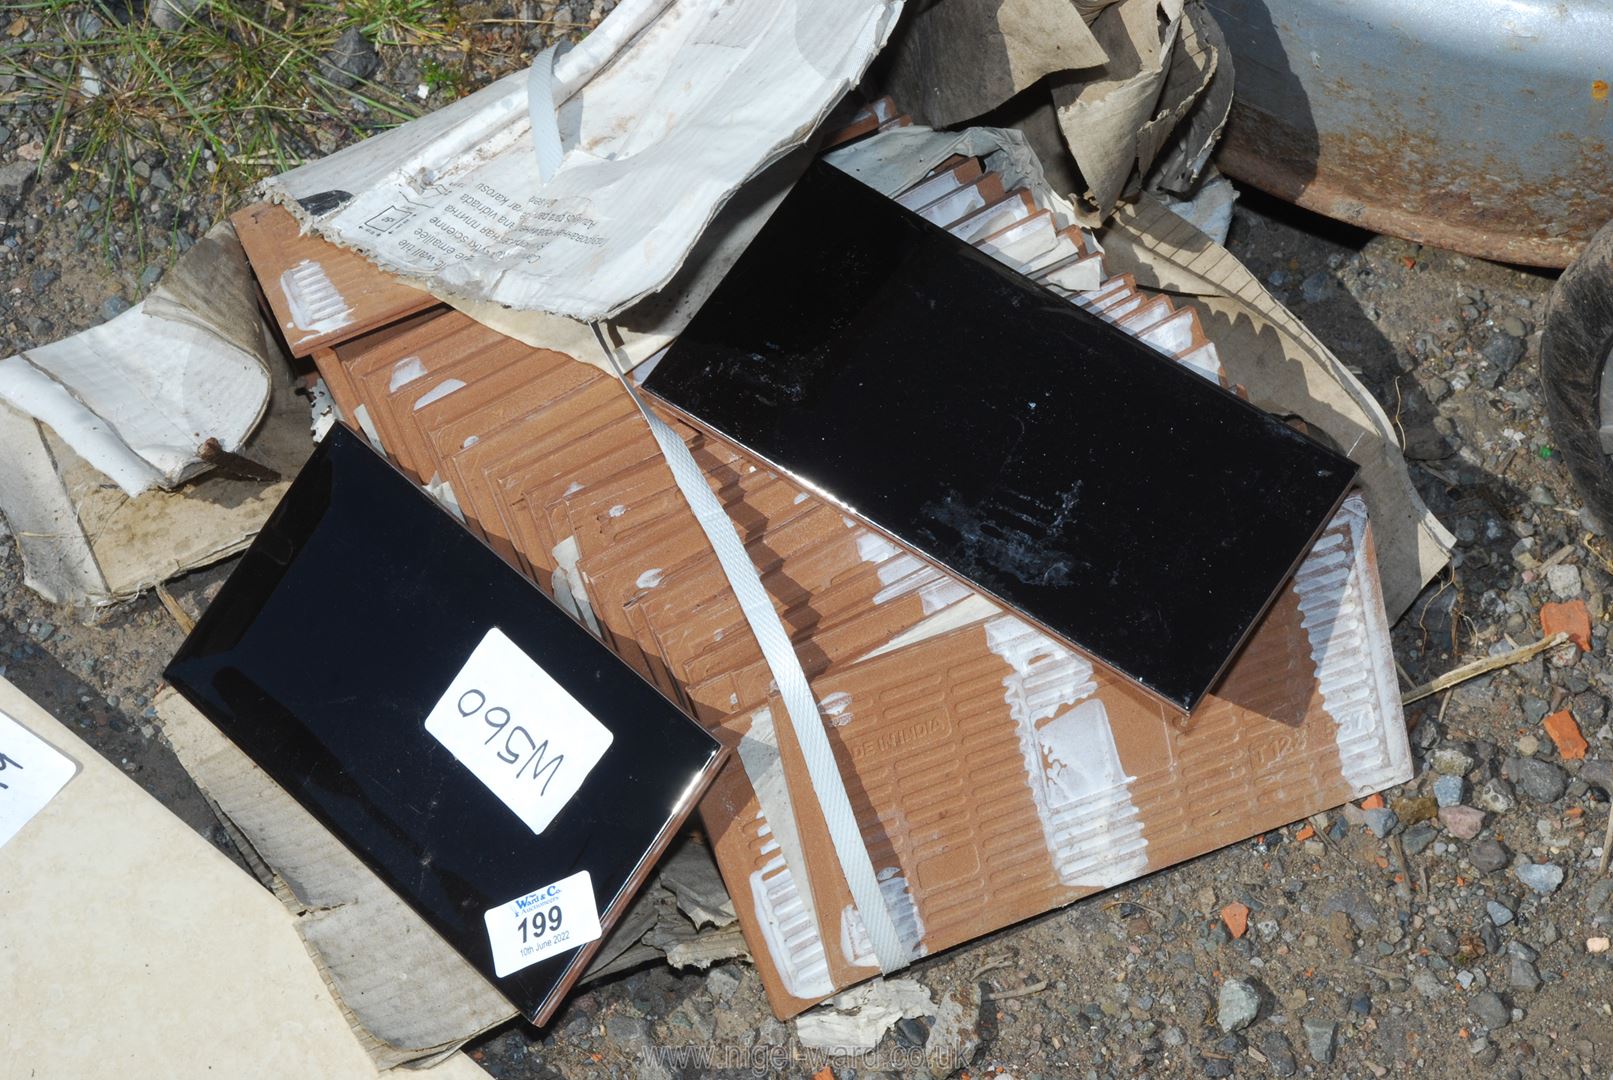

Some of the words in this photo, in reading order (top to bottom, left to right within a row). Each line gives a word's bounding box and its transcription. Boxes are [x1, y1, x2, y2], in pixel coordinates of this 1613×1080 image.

[398, 240, 415, 253] tile
[411, 248, 435, 263] wall
[458, 689, 564, 796] W560
[515, 895, 539, 909] Ward
[518, 905, 562, 944] 199
[520, 945, 534, 957] 10th
[535, 939, 552, 952] June
[553, 930, 570, 944] 2022
